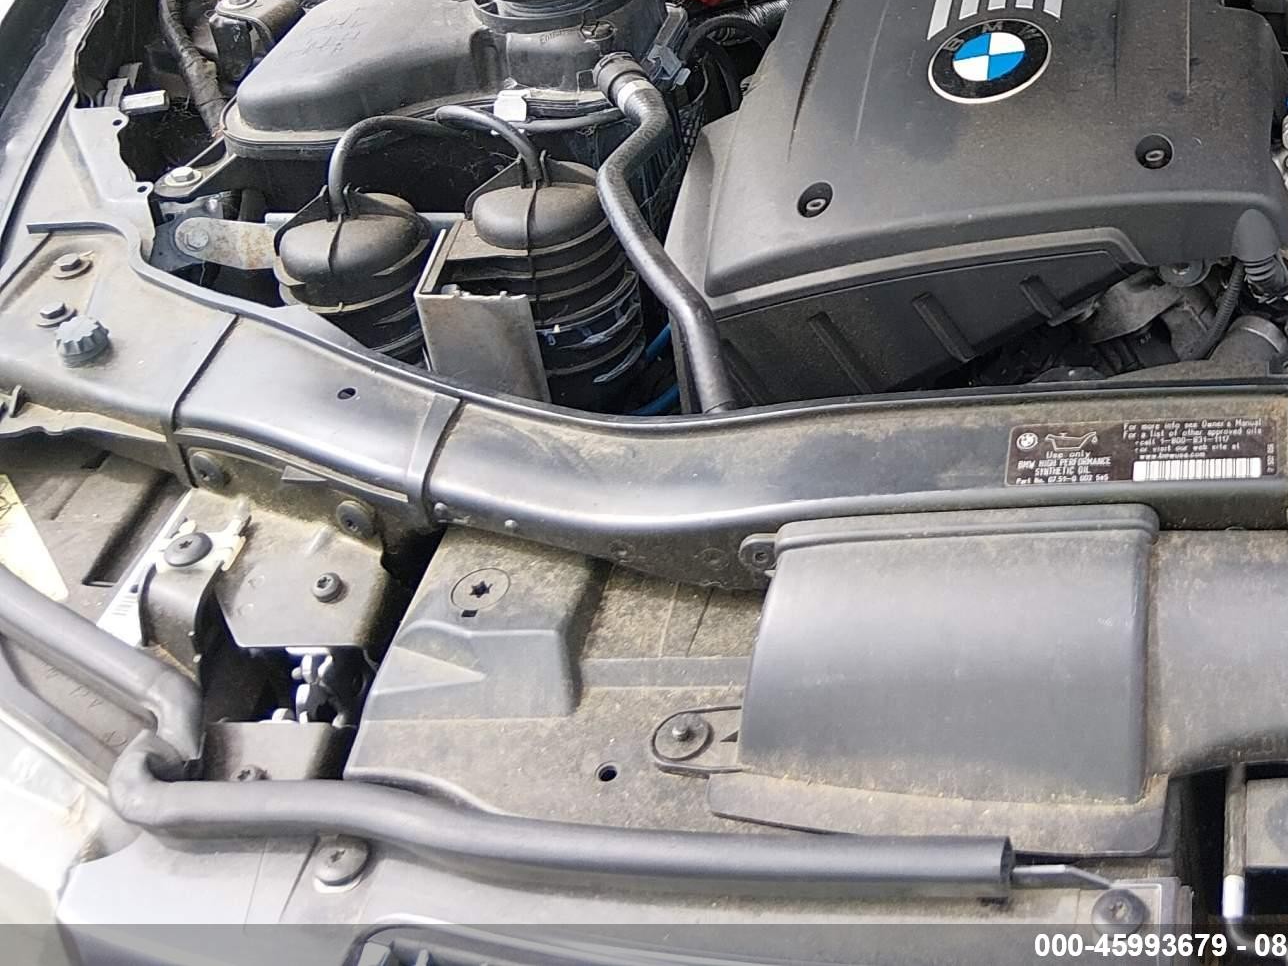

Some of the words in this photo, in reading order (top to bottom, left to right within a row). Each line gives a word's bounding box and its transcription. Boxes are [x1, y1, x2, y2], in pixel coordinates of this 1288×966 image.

[943, 21, 1042, 52] BMW
[1123, 422, 1137, 431] For
[1235, 418, 1262, 427] Manual
[1123, 430, 1137, 440] For
[1150, 429, 1164, 438] list
[1182, 428, 1203, 436] other
[1207, 427, 1243, 436] approved
[1246, 426, 1262, 435] oils
[1046, 451, 1064, 459] Use
[1069, 450, 1091, 460] only
[1059, 456, 1112, 466] PERFORMANCE
[1035, 466, 1075, 476] SYNTHETIC
[1078, 465, 1091, 474] OIL
